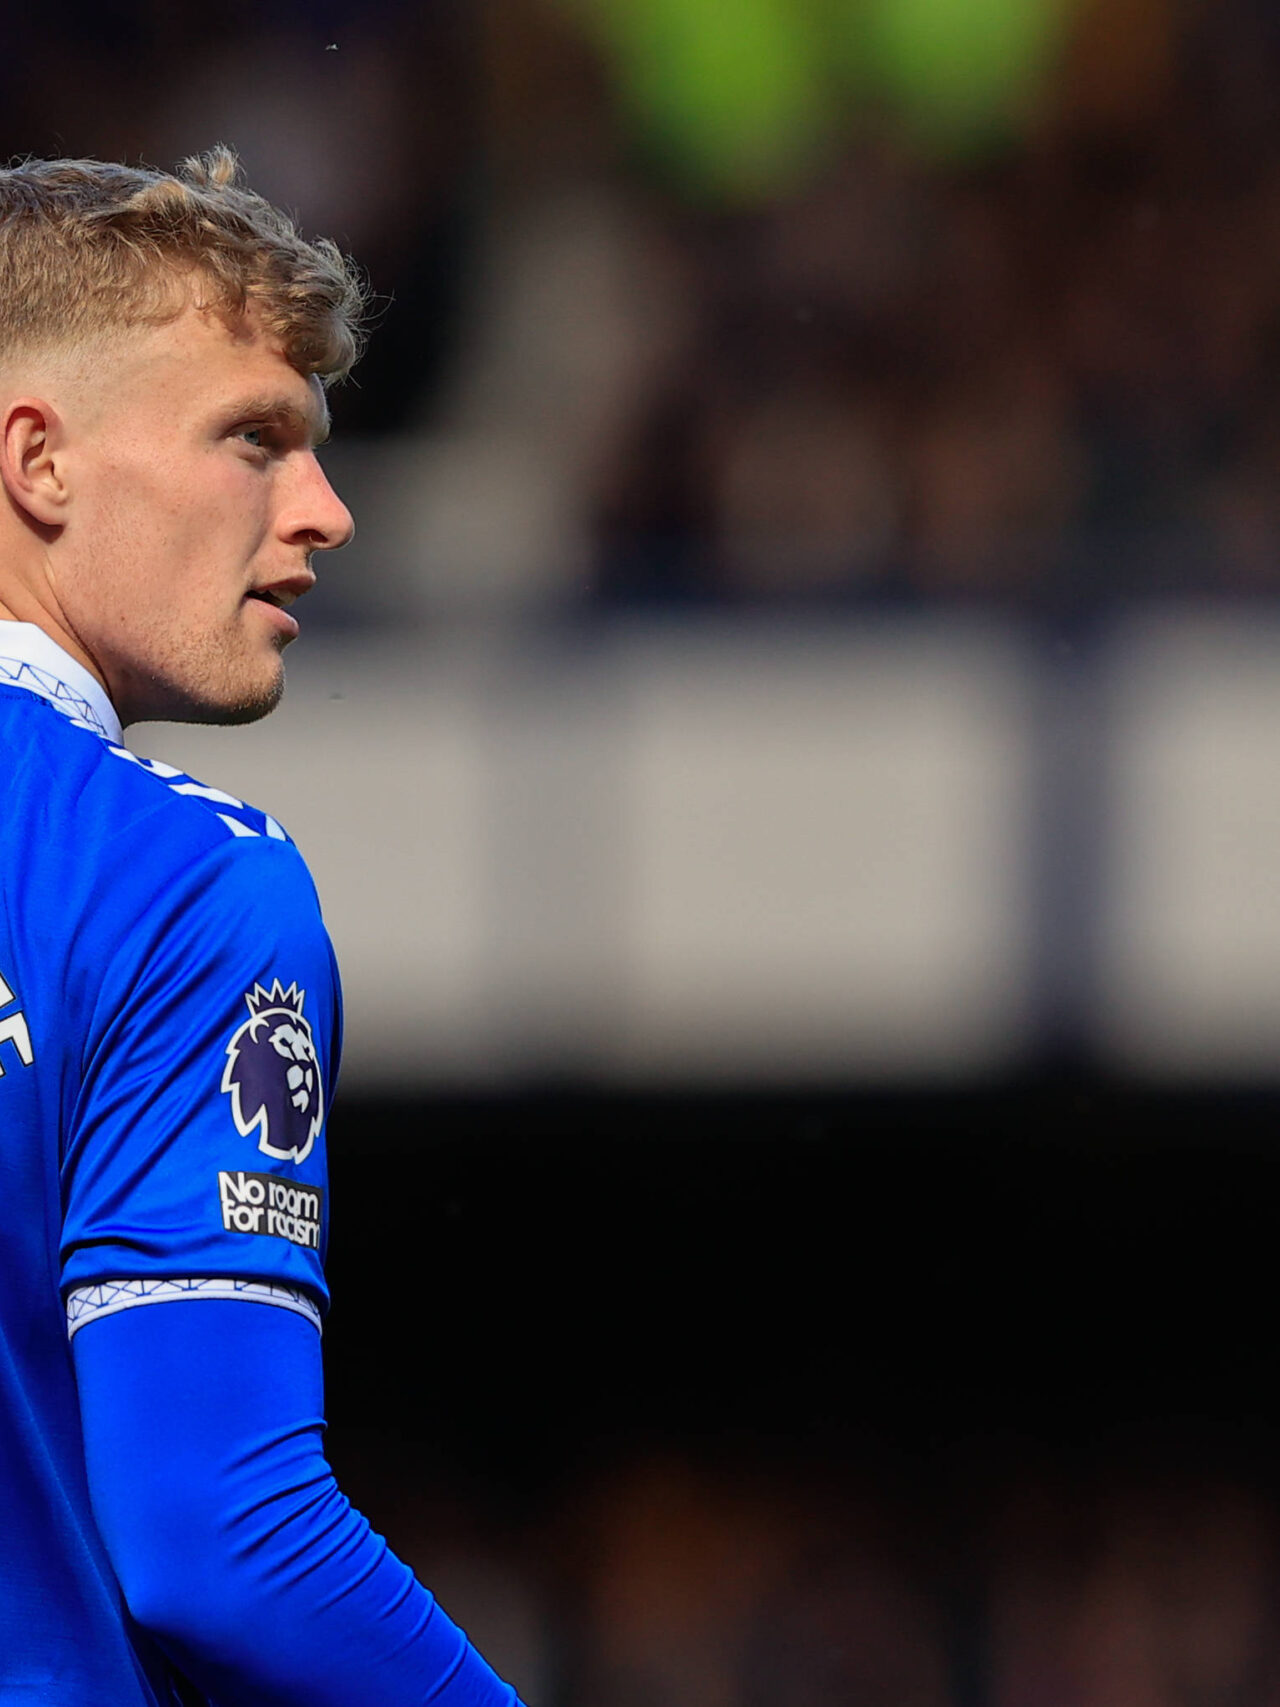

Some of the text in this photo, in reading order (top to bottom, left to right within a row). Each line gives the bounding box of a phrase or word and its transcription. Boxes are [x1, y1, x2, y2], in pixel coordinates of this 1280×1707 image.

[218, 1171, 319, 1220] No room
[267, 1208, 320, 1248] racism
